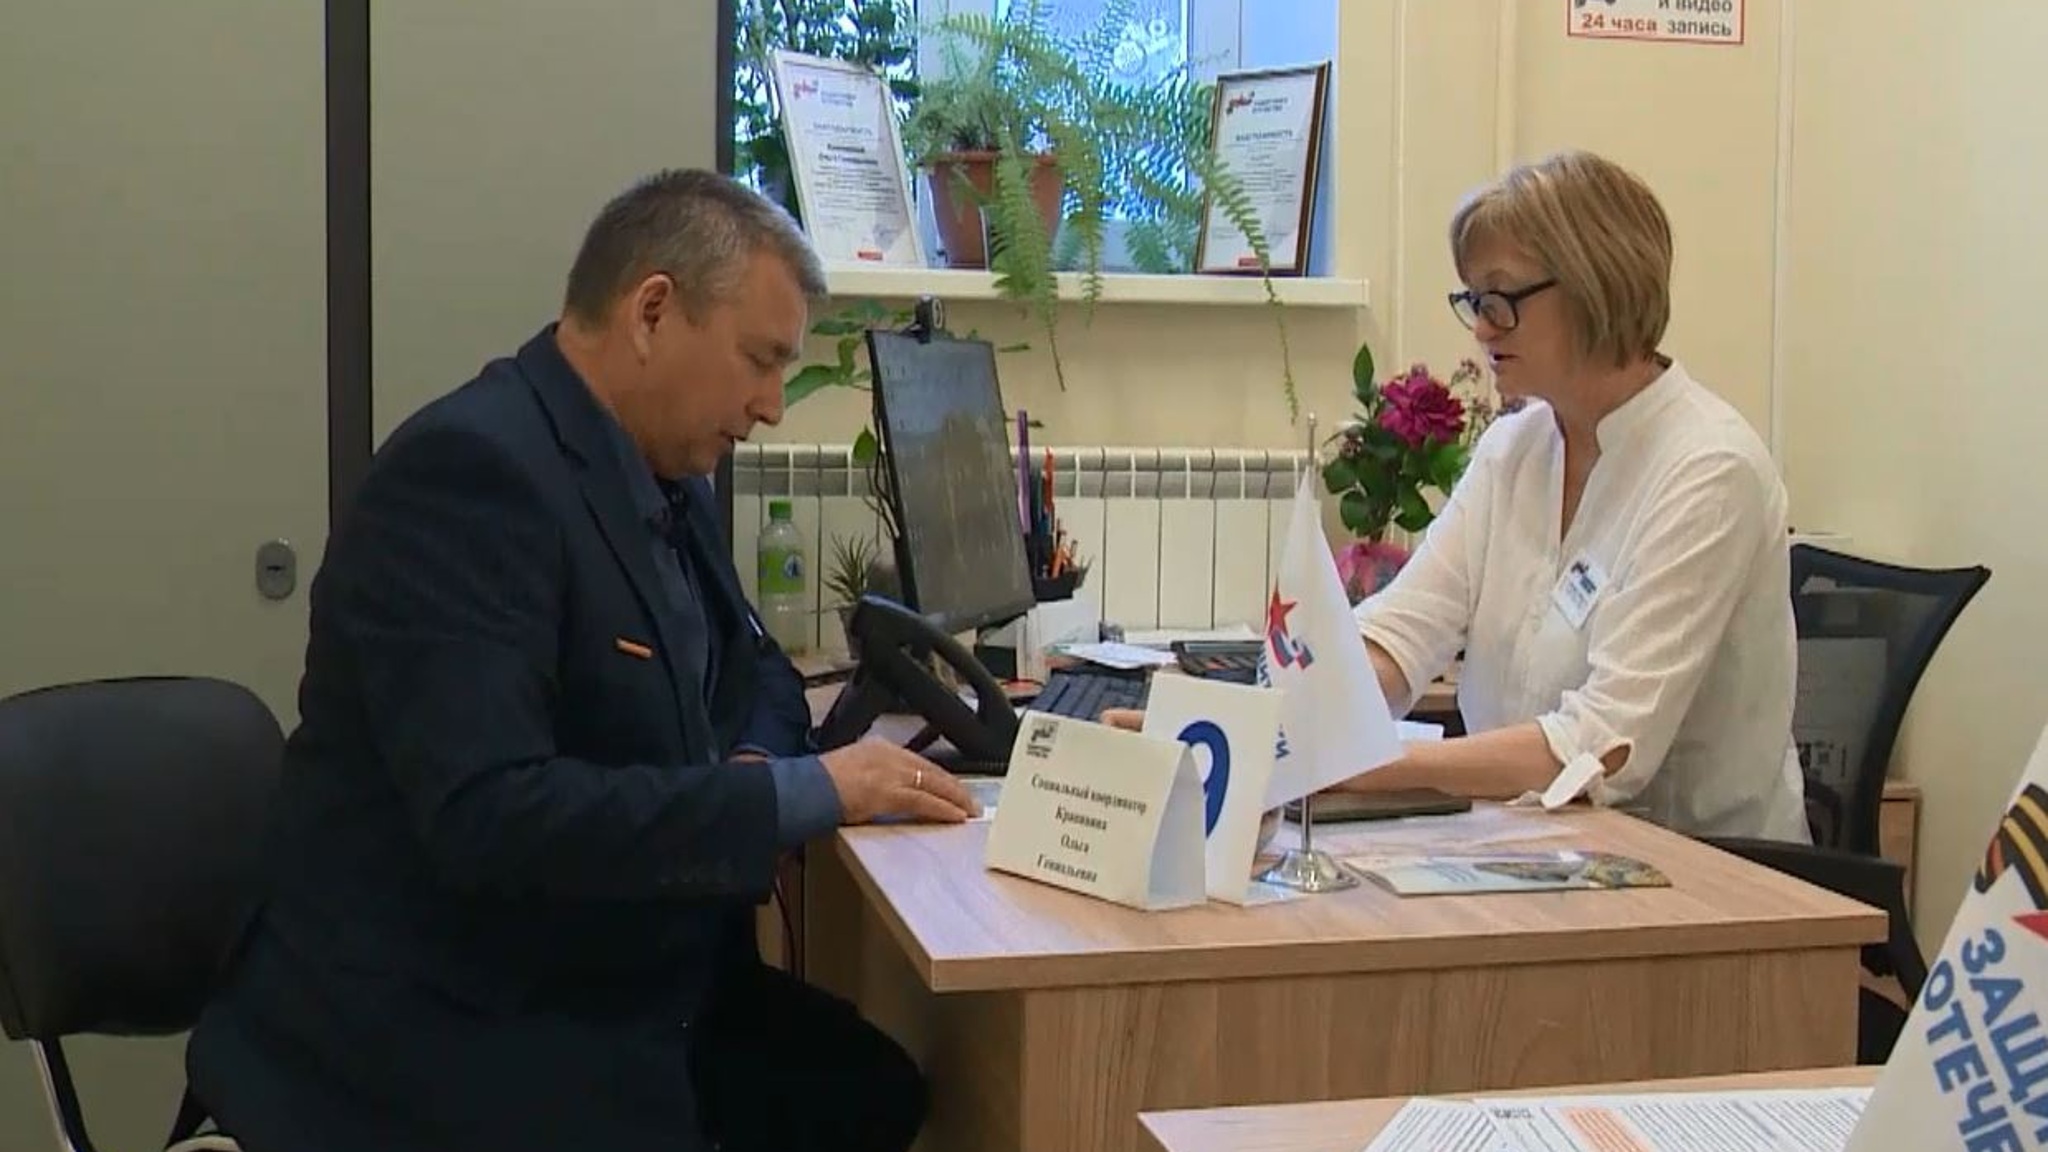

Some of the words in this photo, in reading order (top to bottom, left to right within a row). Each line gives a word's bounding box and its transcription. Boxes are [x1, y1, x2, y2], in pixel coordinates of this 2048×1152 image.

[1675, 0, 1732, 13] видео
[1582, 13, 1605, 29] 24
[1611, 18, 1657, 32] часа
[1667, 20, 1732, 37] запись
